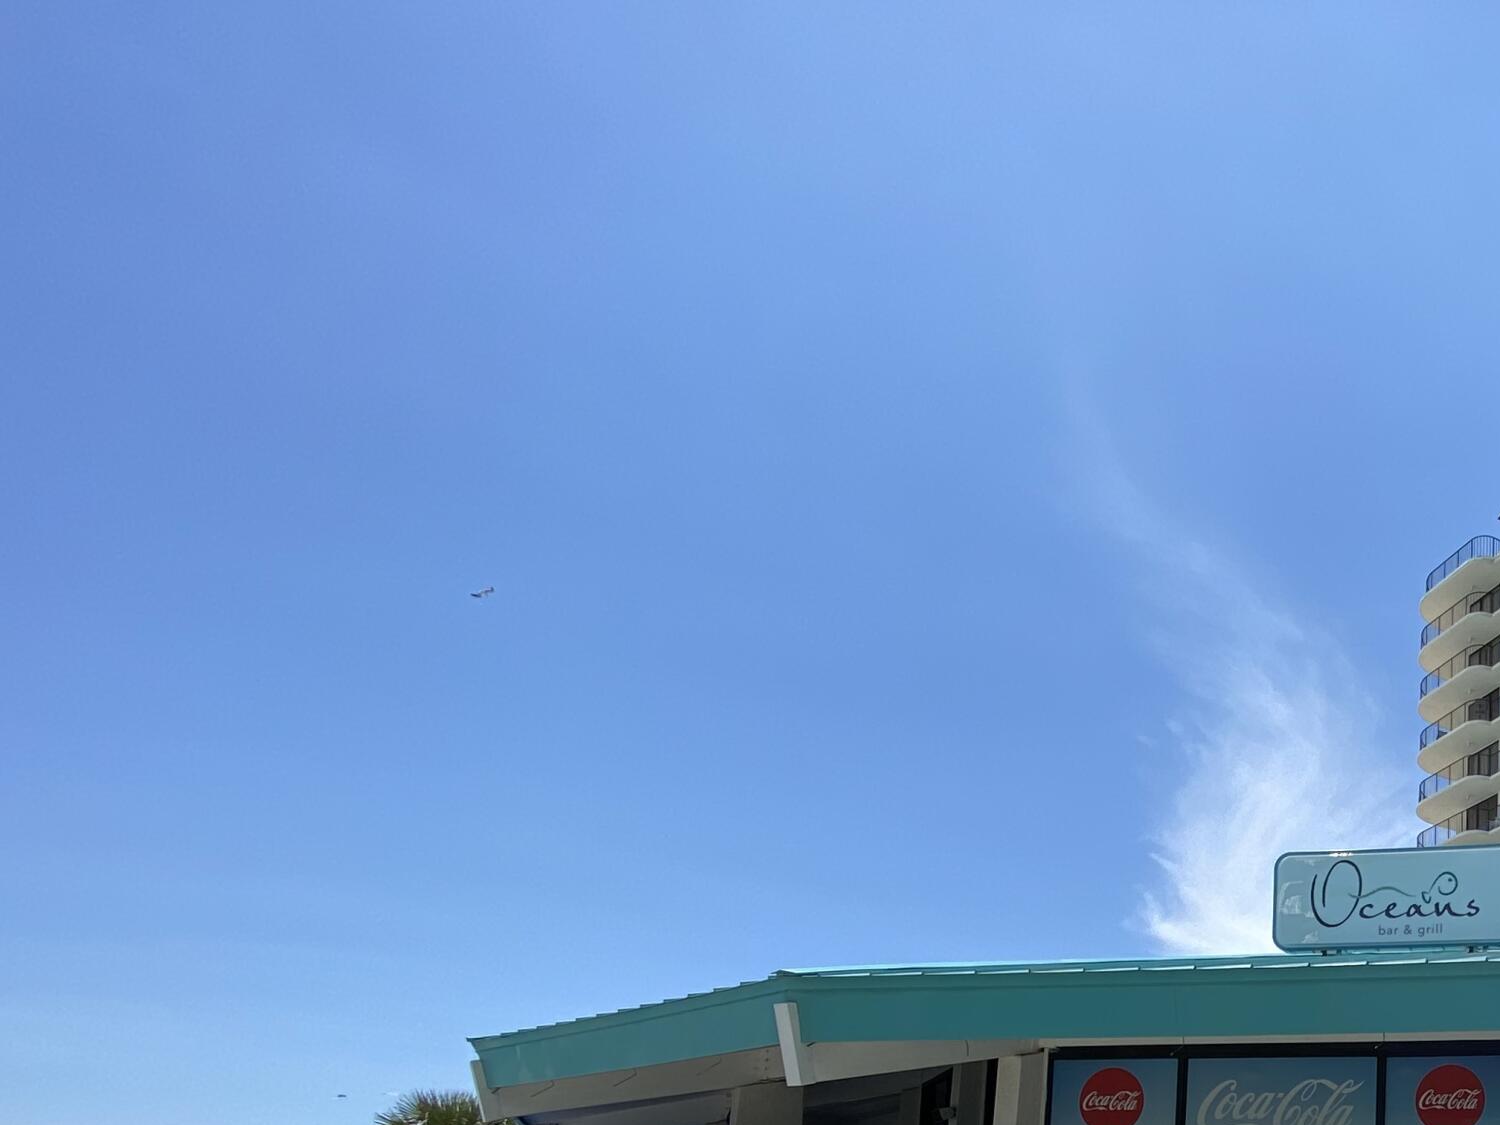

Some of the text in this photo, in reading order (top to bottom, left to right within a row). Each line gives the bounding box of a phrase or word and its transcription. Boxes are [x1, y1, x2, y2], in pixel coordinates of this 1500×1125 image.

[1310, 859, 1481, 928] Oceans
[1378, 923, 1443, 938] bar & grill
[1082, 1090, 1142, 1112] Coca-Cola
[1418, 1088, 1482, 1111] Coca-Cola
